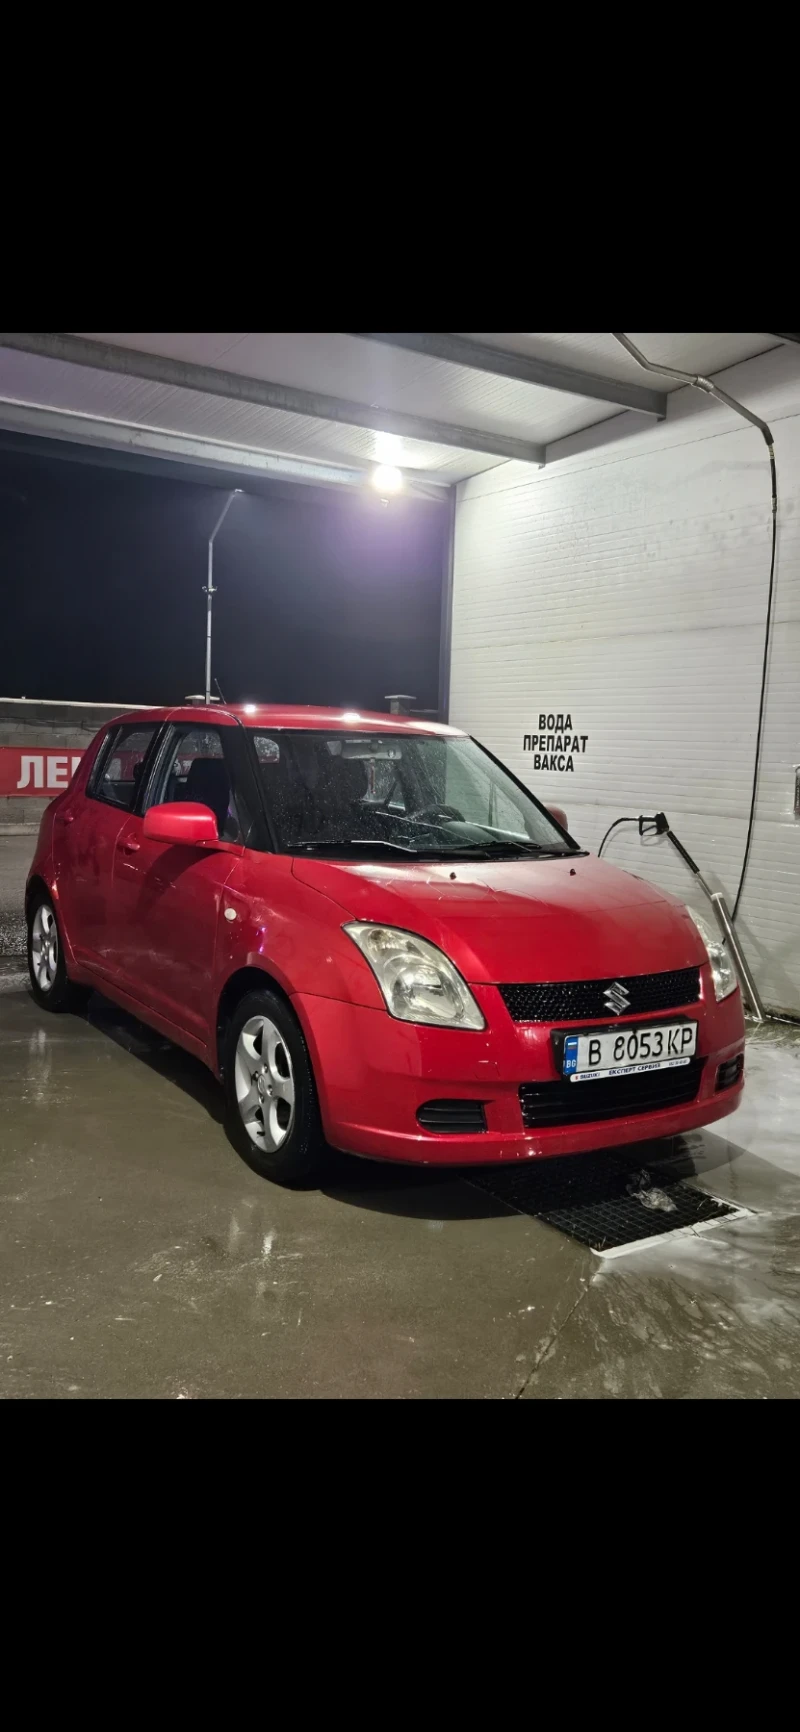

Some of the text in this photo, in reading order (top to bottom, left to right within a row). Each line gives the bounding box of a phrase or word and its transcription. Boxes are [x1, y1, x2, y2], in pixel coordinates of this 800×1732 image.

[538, 714, 573, 734] ВОДА
[523, 735, 589, 753] ПРЕПАРАТ
[533, 754, 575, 772] ВАКСА
[588, 1028, 693, 1066] B 8053 KP
[566, 1059, 577, 1069] BG
[608, 1066, 636, 1075] ЕКСПЕРТ
